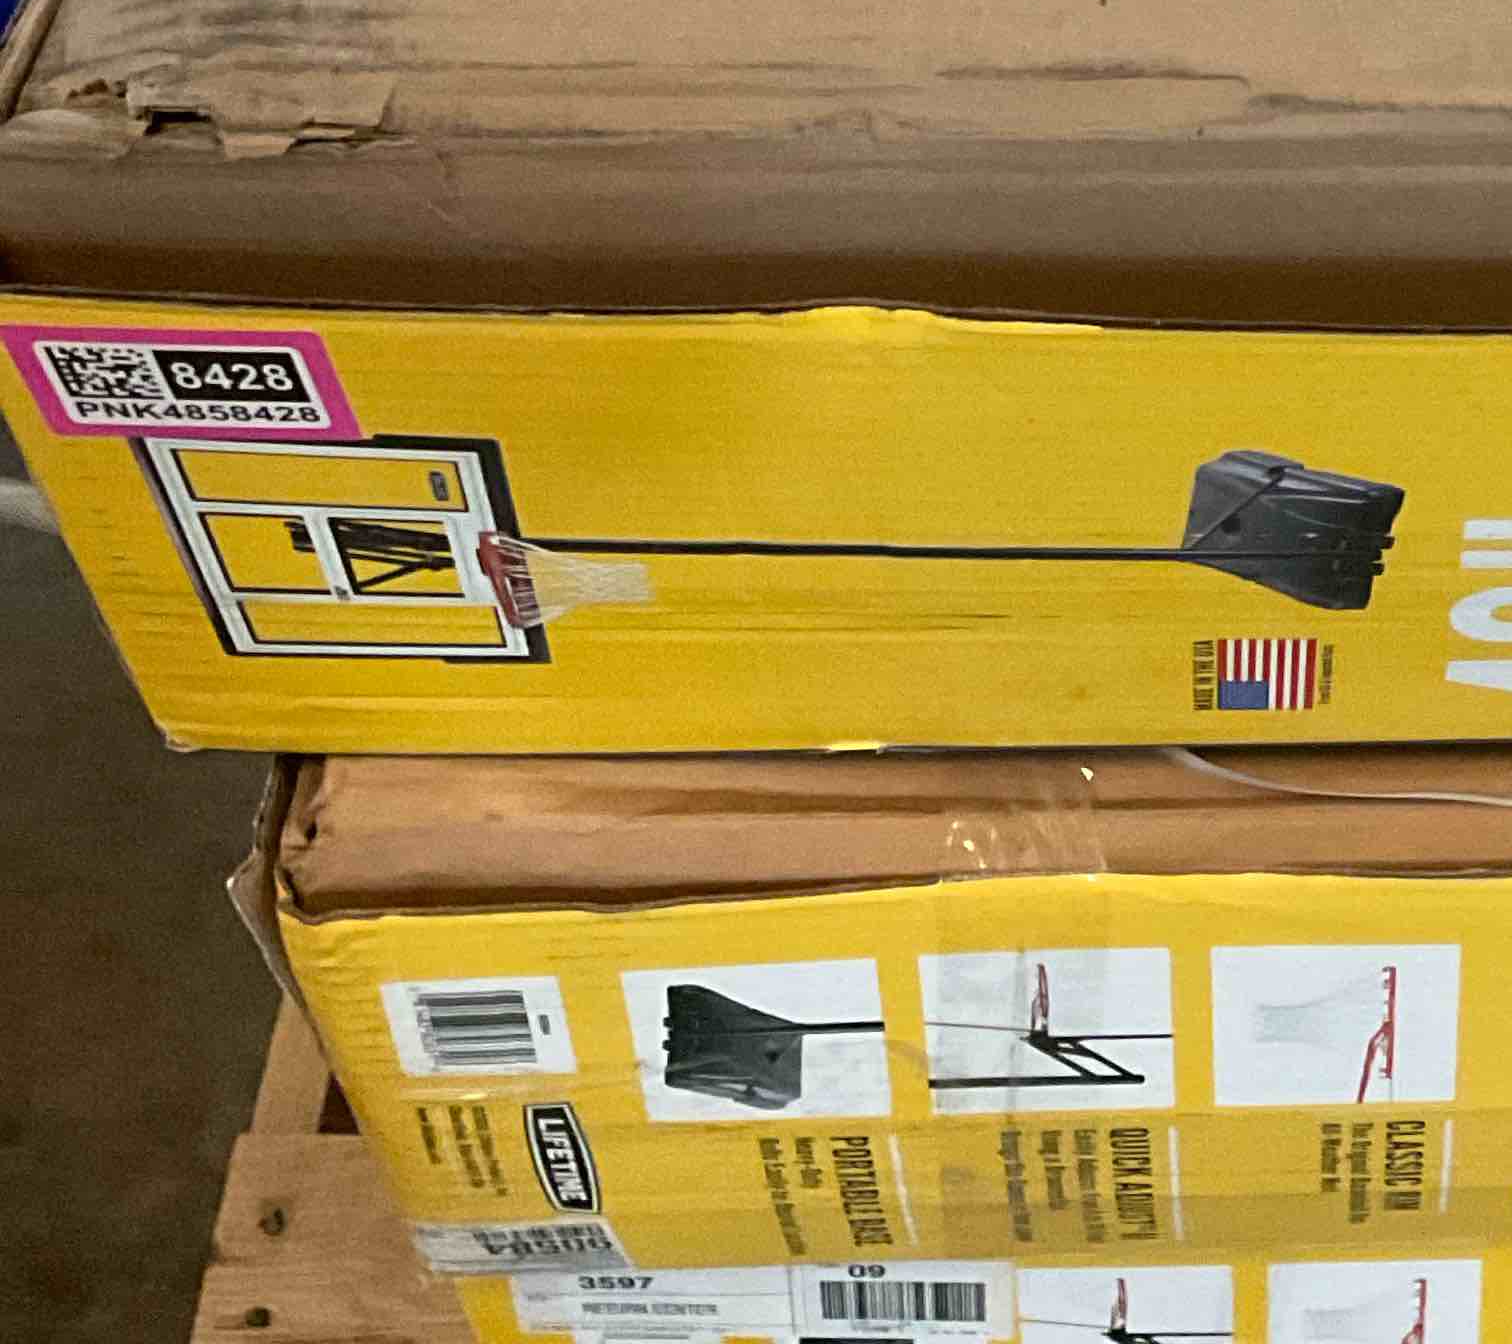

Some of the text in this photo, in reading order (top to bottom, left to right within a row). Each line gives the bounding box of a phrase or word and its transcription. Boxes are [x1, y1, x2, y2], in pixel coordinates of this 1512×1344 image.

[169, 363, 295, 393] 8428
[74, 398, 321, 425] PNK4858428
[537, 1116, 588, 1205] LIFETIME
[1110, 1128, 1152, 1177] QUICK
[1384, 1120, 1426, 1186] CLASSIC
[577, 1275, 655, 1289] 3597
[847, 1263, 886, 1279] 09
